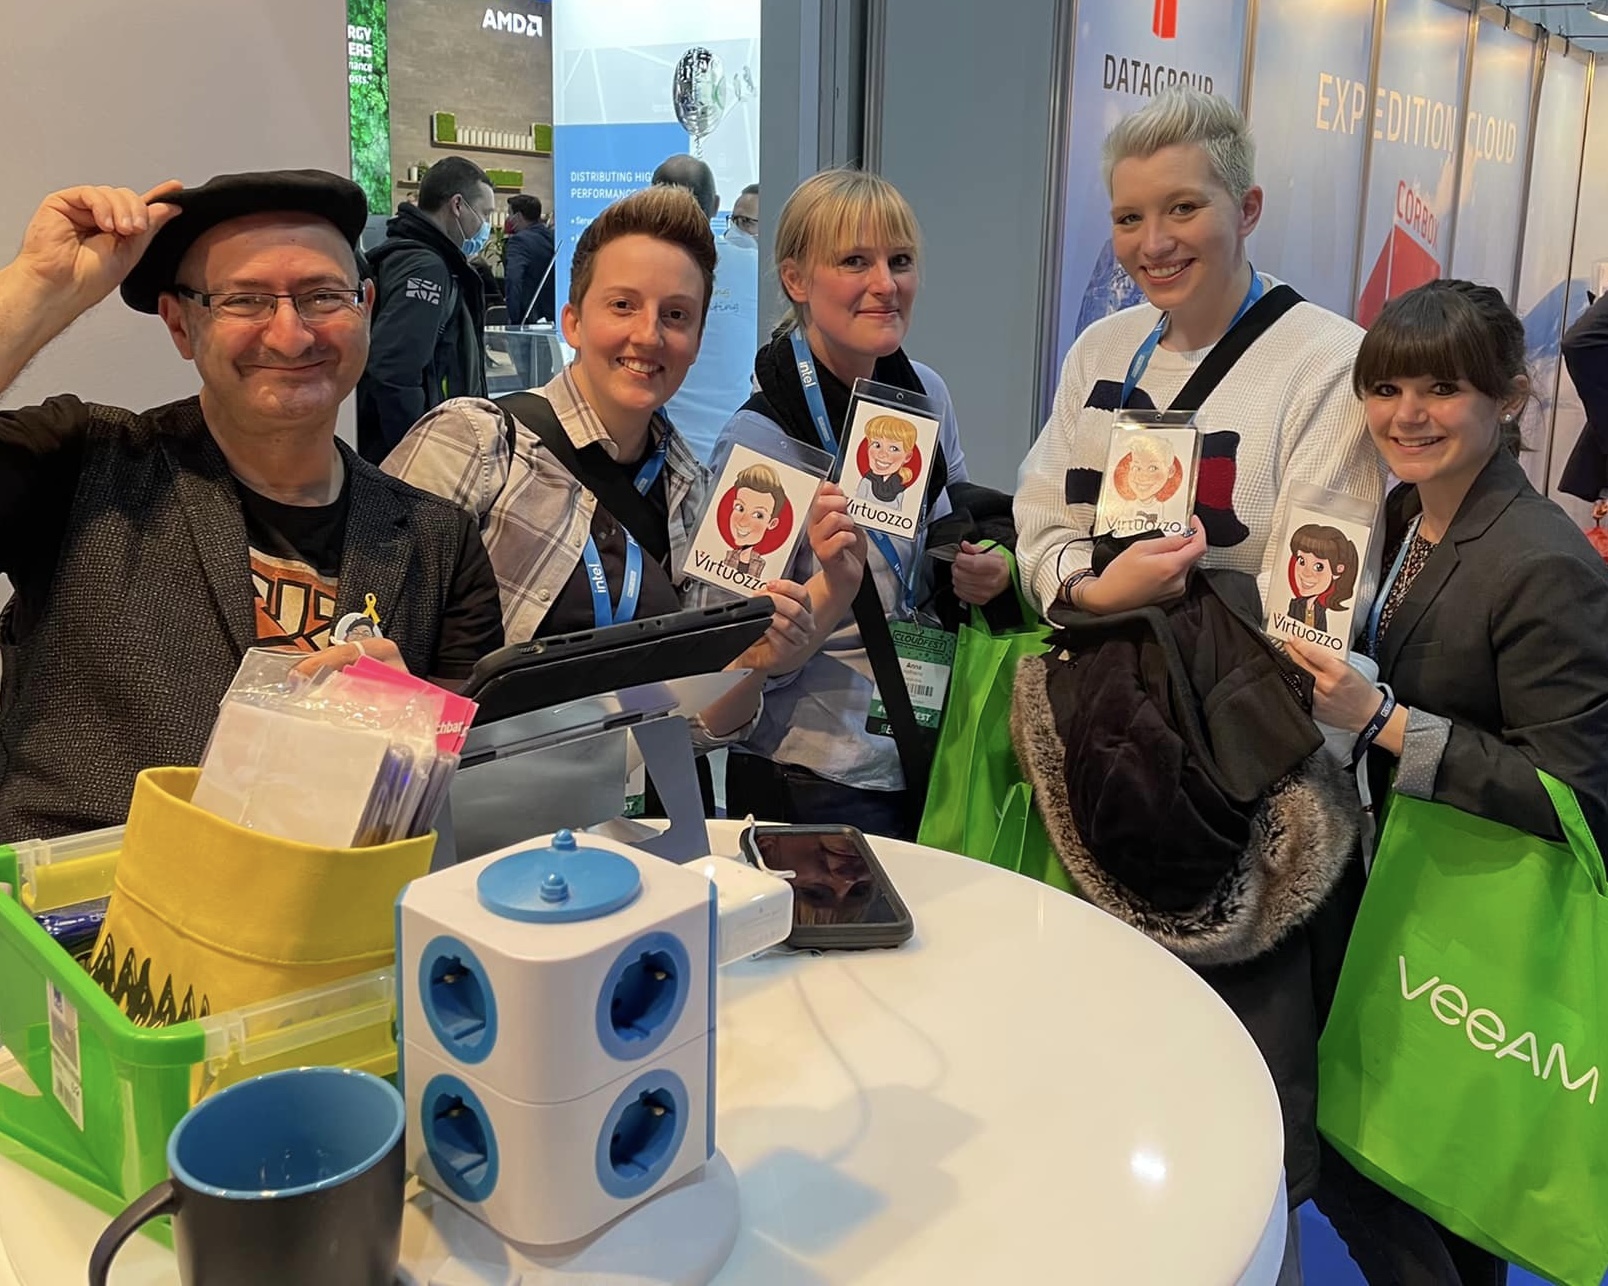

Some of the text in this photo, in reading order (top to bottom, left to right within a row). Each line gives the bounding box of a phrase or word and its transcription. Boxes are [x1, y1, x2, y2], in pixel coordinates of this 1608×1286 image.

[482, 8, 527, 34] AMD
[348, 42, 373, 57] ERS
[570, 171, 653, 182] DISTRIBUTING HIG
[570, 188, 637, 199] PERFORMANC
[1396, 179, 1440, 250] CORBOX
[588, 563, 607, 593] intel
[894, 632, 944, 650] CLOUDFEST
[1273, 612, 1343, 651] Virtuozzo
